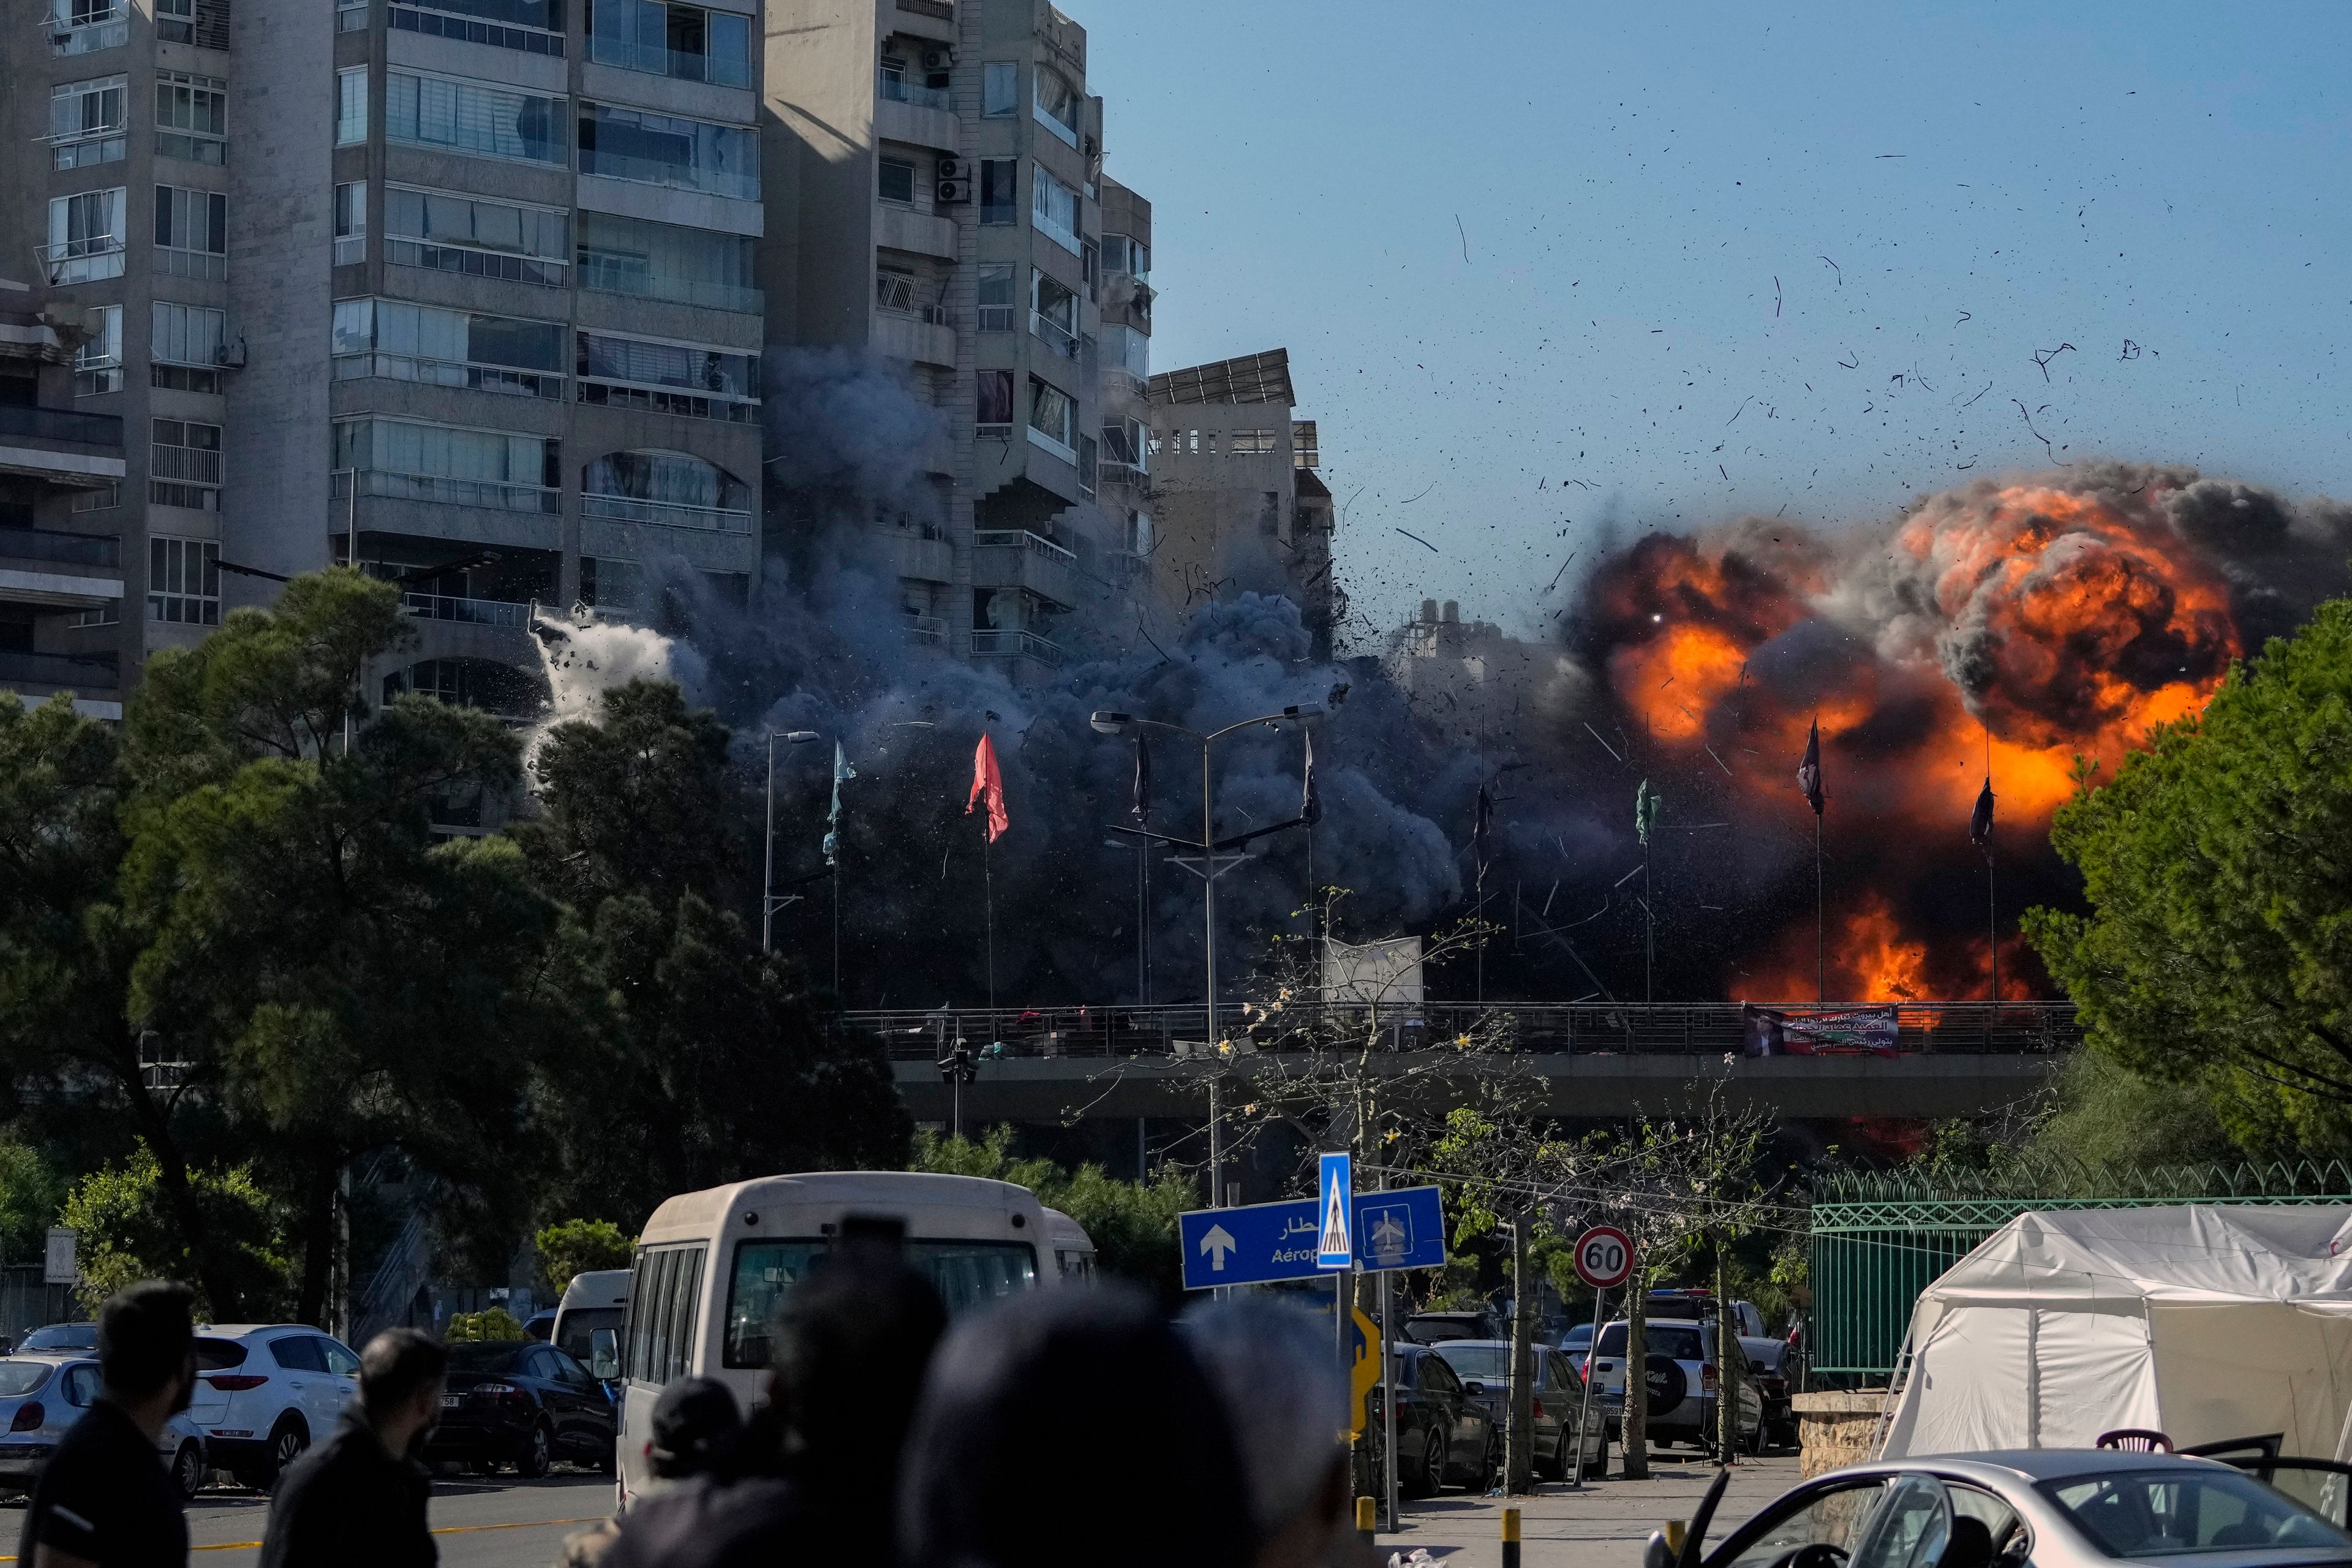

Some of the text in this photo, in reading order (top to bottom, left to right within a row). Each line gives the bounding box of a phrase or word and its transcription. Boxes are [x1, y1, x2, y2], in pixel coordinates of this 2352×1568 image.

[1829, 1013, 1850, 1023] تبارك
[1877, 1007, 1893, 1019] أهل
[1852, 1019, 1888, 1034] العميد
[1849, 1038, 1871, 1046] رئيس
[1872, 1038, 1893, 1048] بتولي
[1278, 1216, 1319, 1240] طار
[1272, 1248, 1317, 1264] Aérop
[1585, 1242, 1623, 1272] 60
[1646, 1386, 1660, 1396] OYOTA
